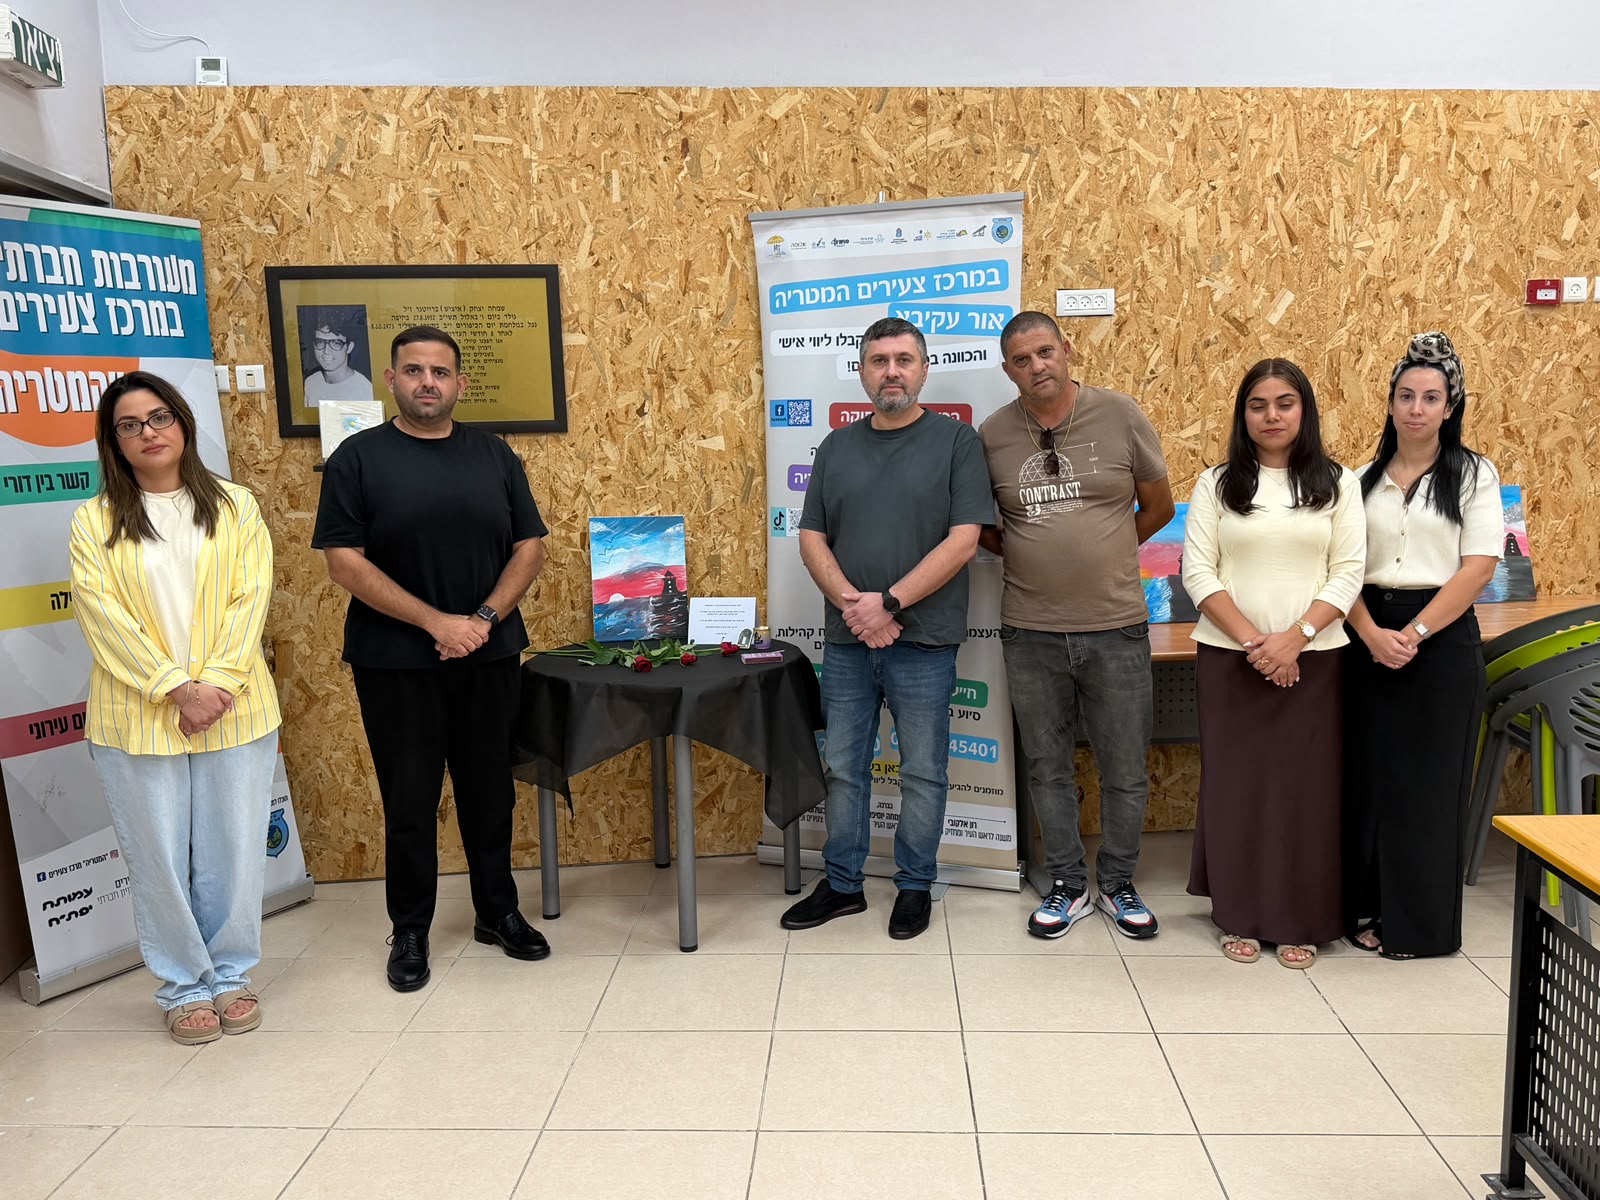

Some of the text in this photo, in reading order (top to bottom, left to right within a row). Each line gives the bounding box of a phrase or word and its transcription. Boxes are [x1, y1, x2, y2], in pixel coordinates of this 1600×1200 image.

[0, 241, 197, 295] מעורבות חברתי
[774, 267, 1001, 309] במרכז צעירים המטריה
[0, 290, 185, 338] במרכז צעירים
[967, 311, 1005, 330] אור
[778, 336, 805, 348] אישי
[809, 333, 832, 347] ליווי
[942, 349, 987, 364] והכוונה
[3, 471, 90, 494] קשר בין דורי
[1019, 481, 1081, 505] CONTRAST
[957, 708, 981, 721] סיוע
[28, 715, 69, 740] עירוני
[973, 785, 1004, 796] מוזמנים
[42, 886, 93, 911] עמותת
